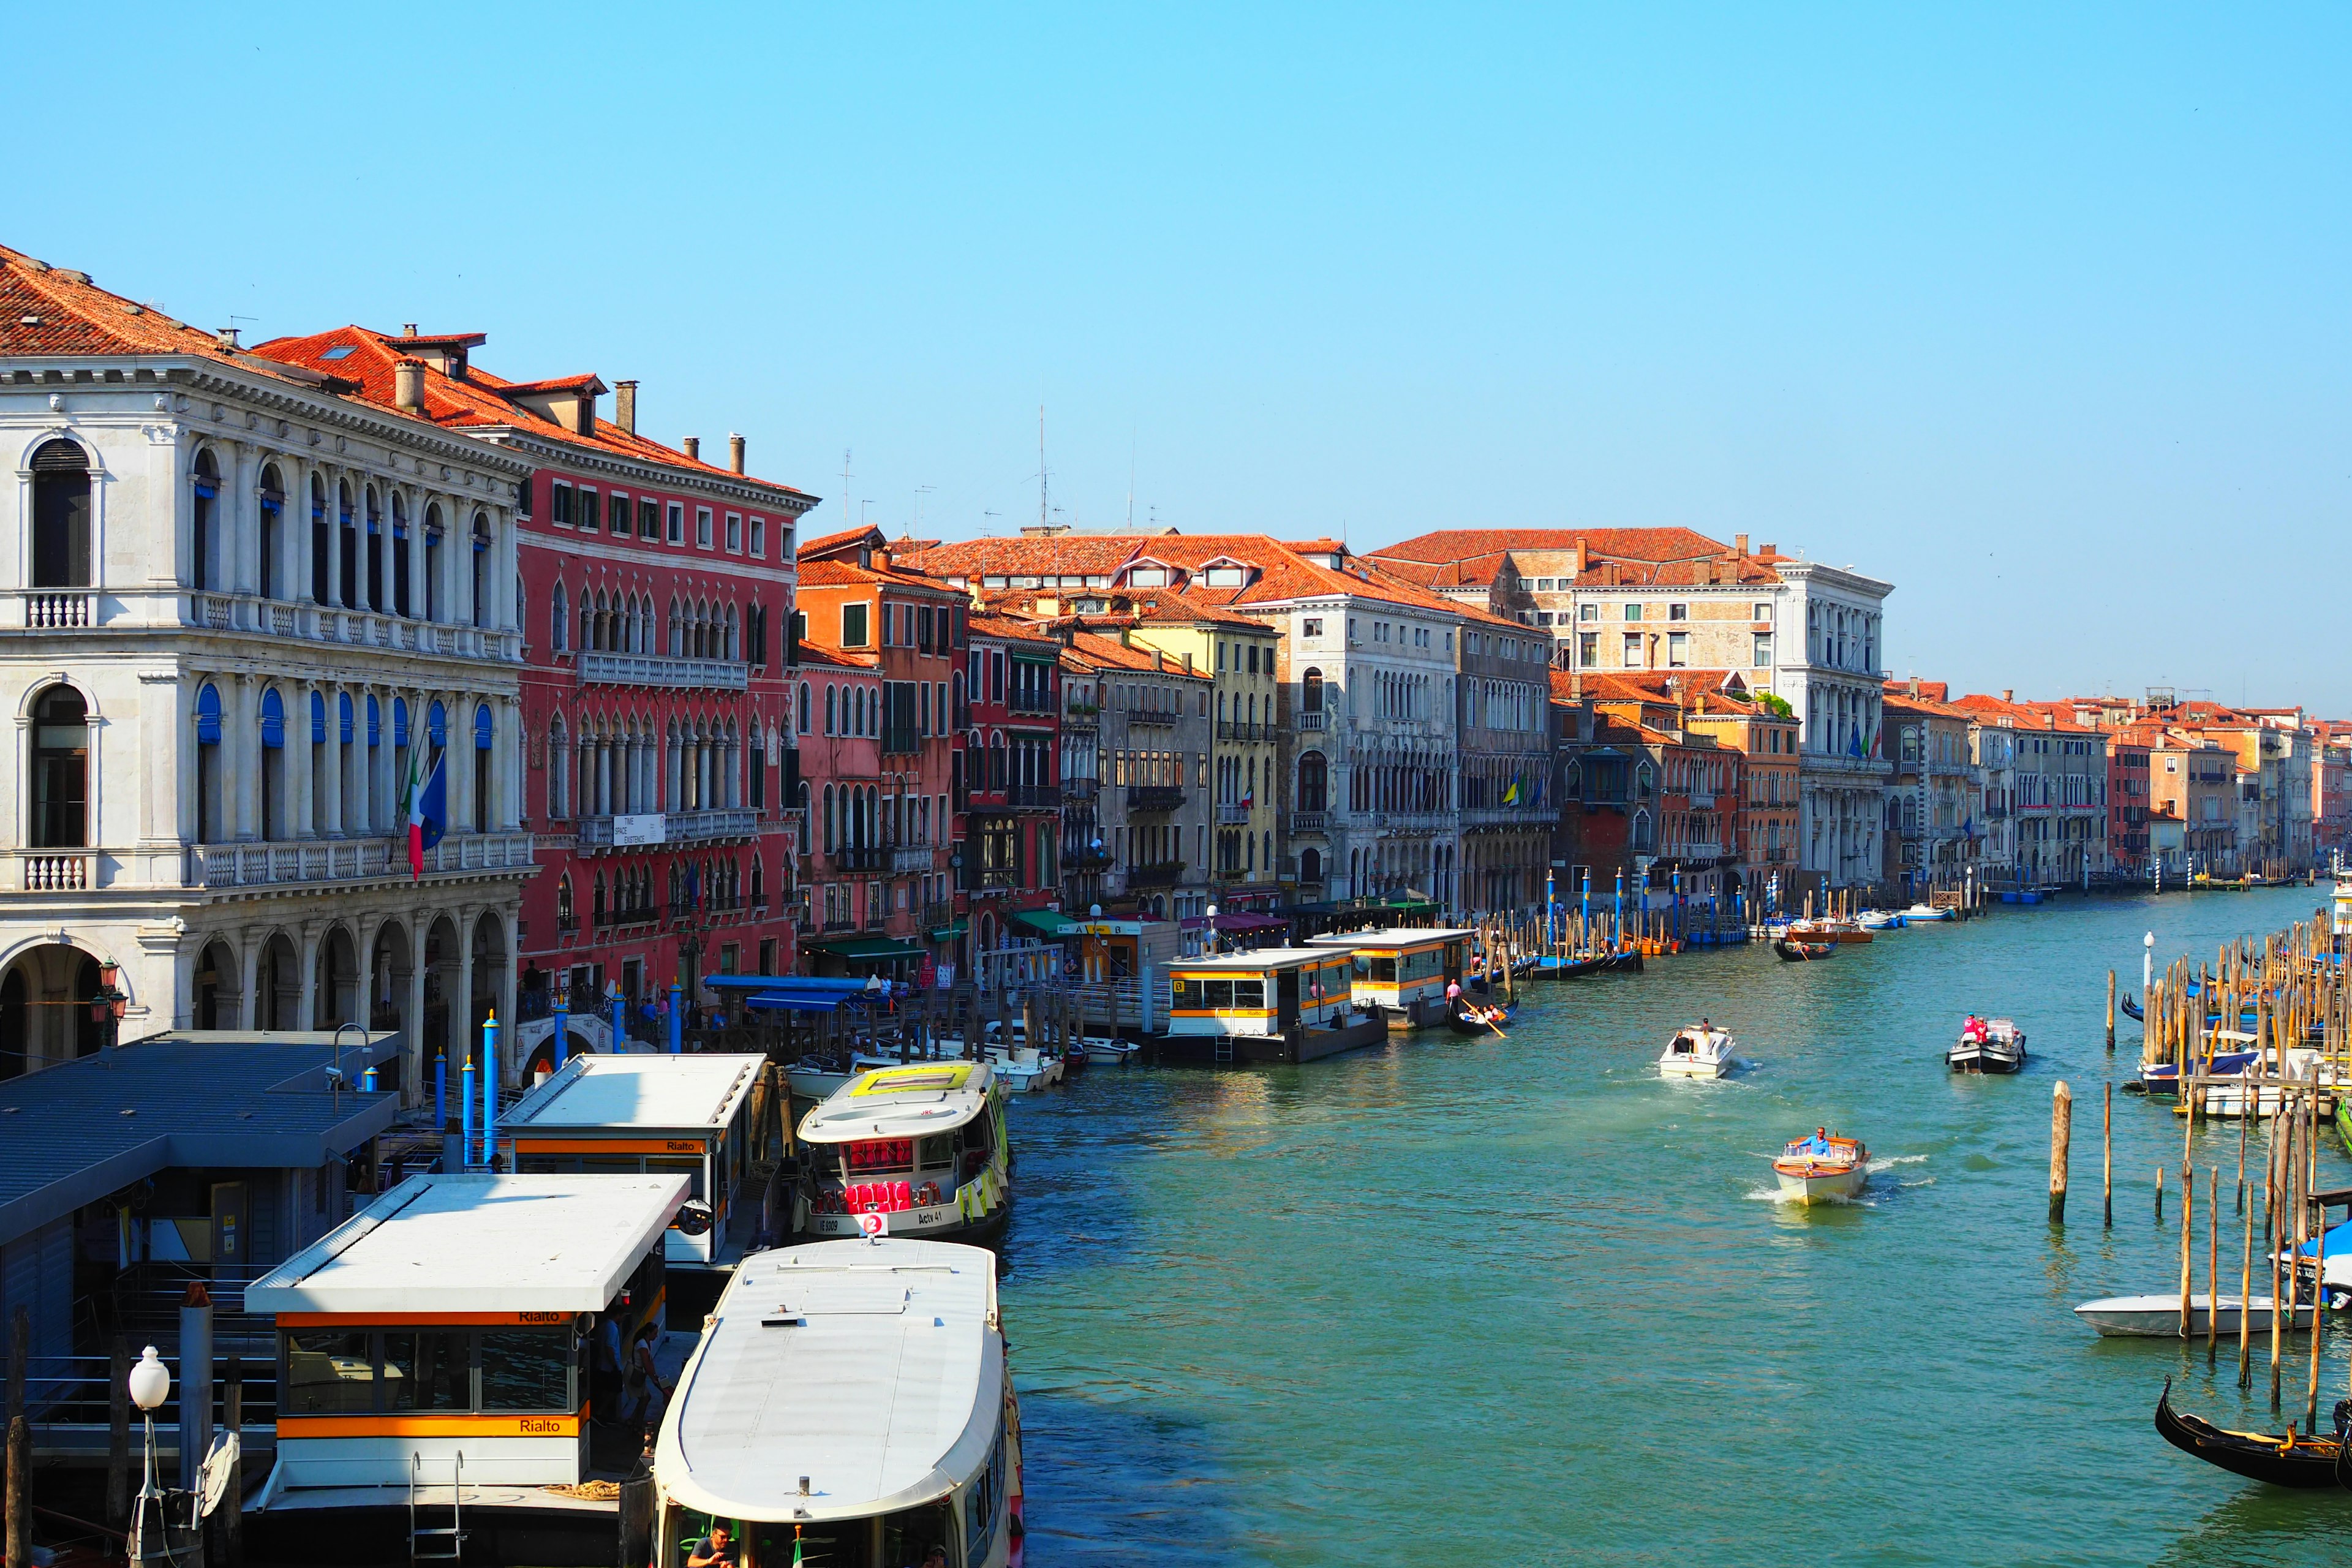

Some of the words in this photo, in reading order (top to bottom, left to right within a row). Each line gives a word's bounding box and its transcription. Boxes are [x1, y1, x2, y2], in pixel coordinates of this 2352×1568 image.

[667, 1142, 694, 1150] Rialto
[919, 1213, 933, 1224] Actv
[935, 1211, 942, 1221] 41
[825, 1220, 838, 1232] 9309
[868, 1218, 877, 1230] 2
[519, 1311, 559, 1322] Rialto
[520, 1420, 560, 1432] Rialto
